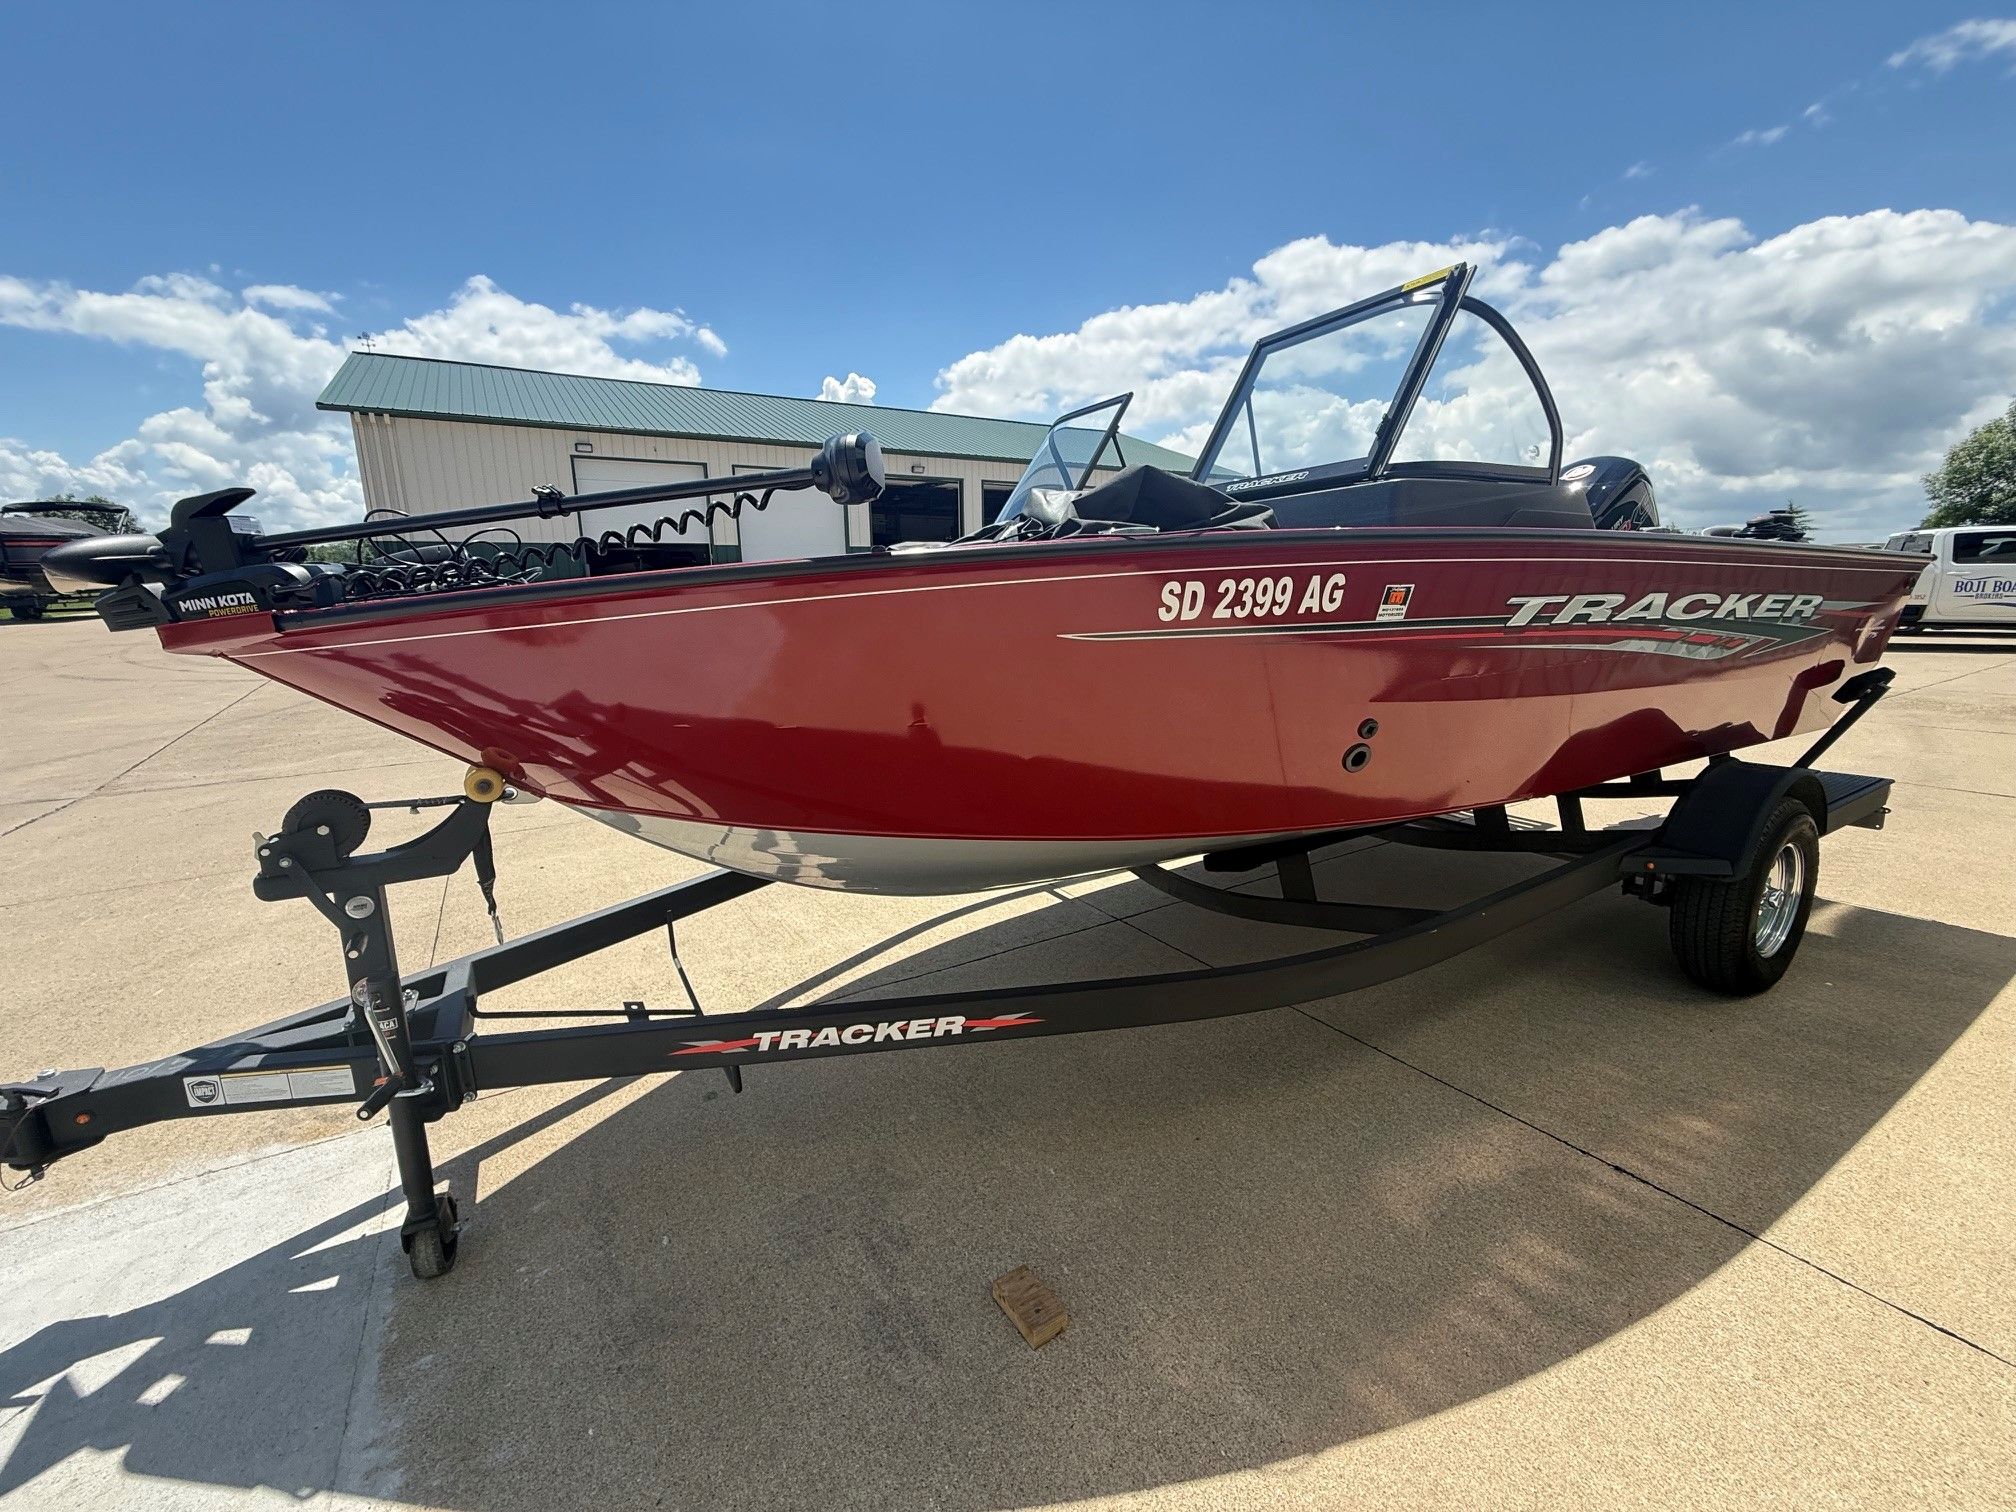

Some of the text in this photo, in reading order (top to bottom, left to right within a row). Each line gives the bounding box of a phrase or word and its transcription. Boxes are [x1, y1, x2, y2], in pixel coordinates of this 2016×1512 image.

[1158, 572, 1347, 622] SD 2399 AG
[1954, 580, 1987, 593] BOJI
[178, 592, 256, 612] MINN KOTA
[208, 604, 260, 617] POWERDRIVE
[1505, 592, 1824, 628] TRACKER
[752, 1015, 966, 1051] TRACKER
